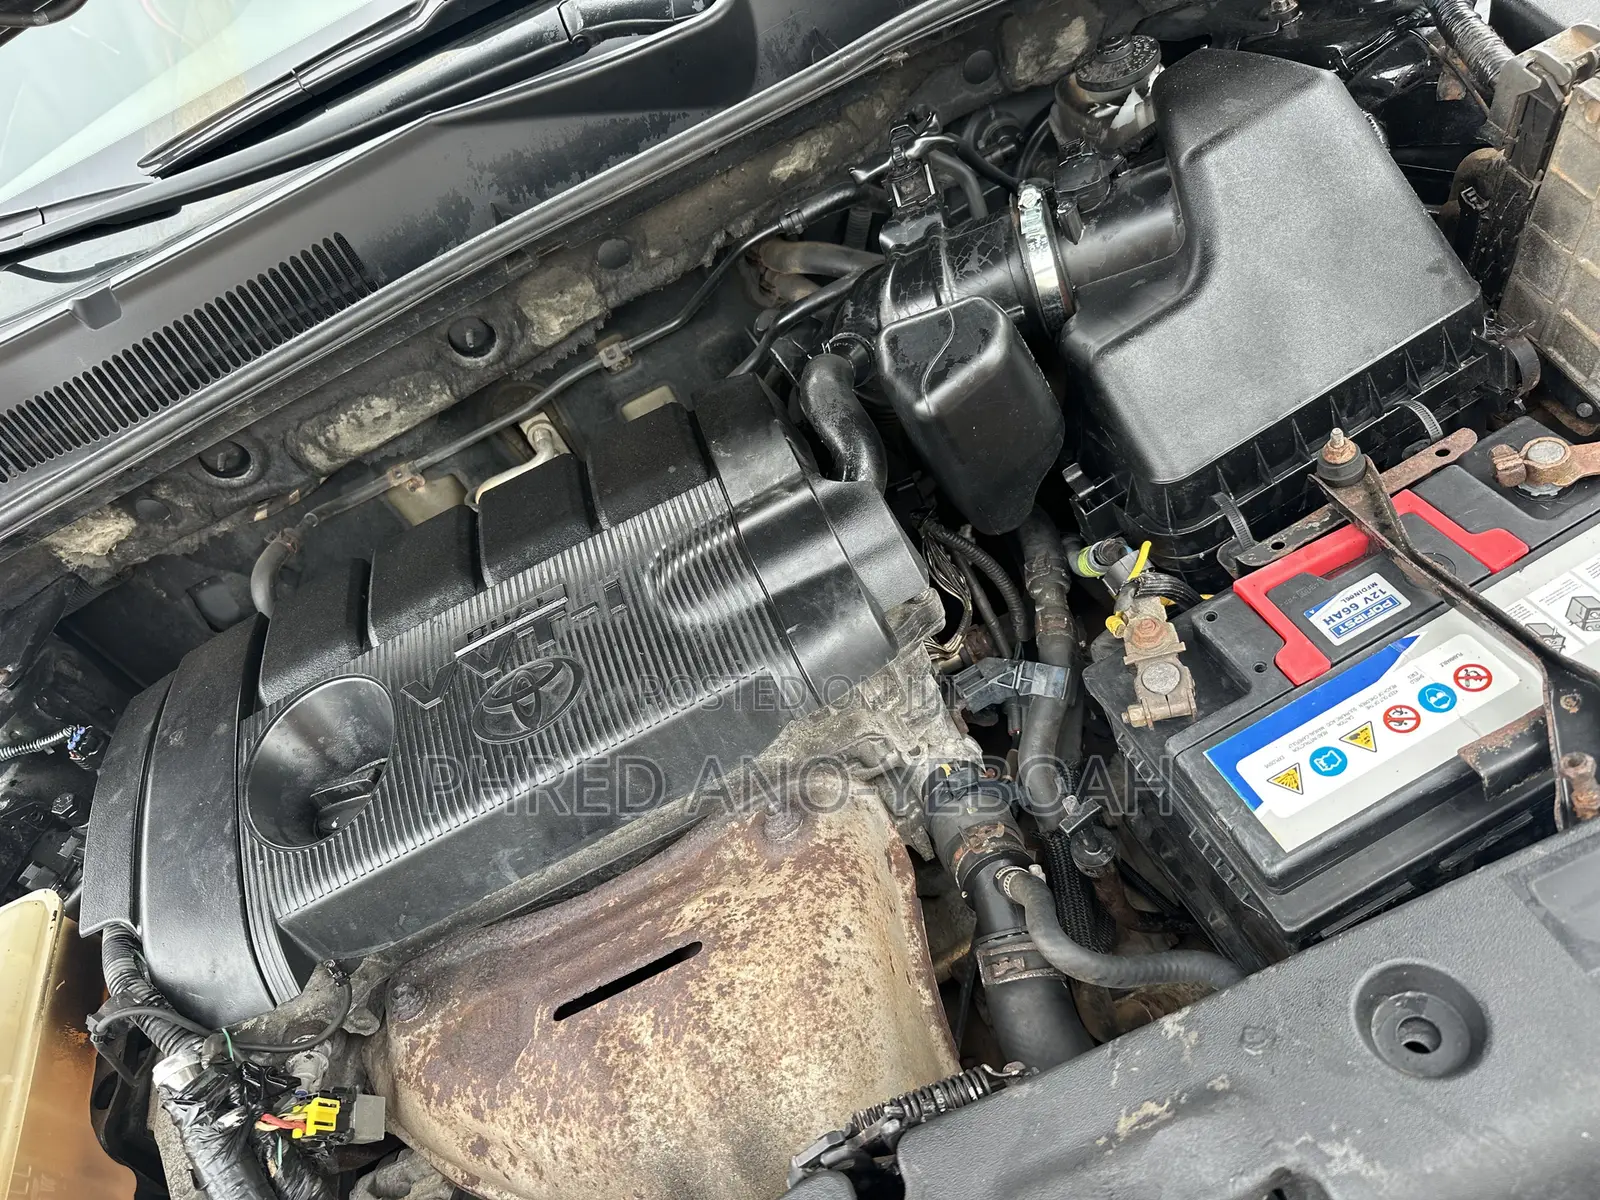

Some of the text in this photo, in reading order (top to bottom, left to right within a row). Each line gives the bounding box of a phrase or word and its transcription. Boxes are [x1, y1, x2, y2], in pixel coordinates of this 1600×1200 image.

[1322, 589, 1386, 626] 12V 66AH
[1338, 599, 1393, 633] POFIRST
